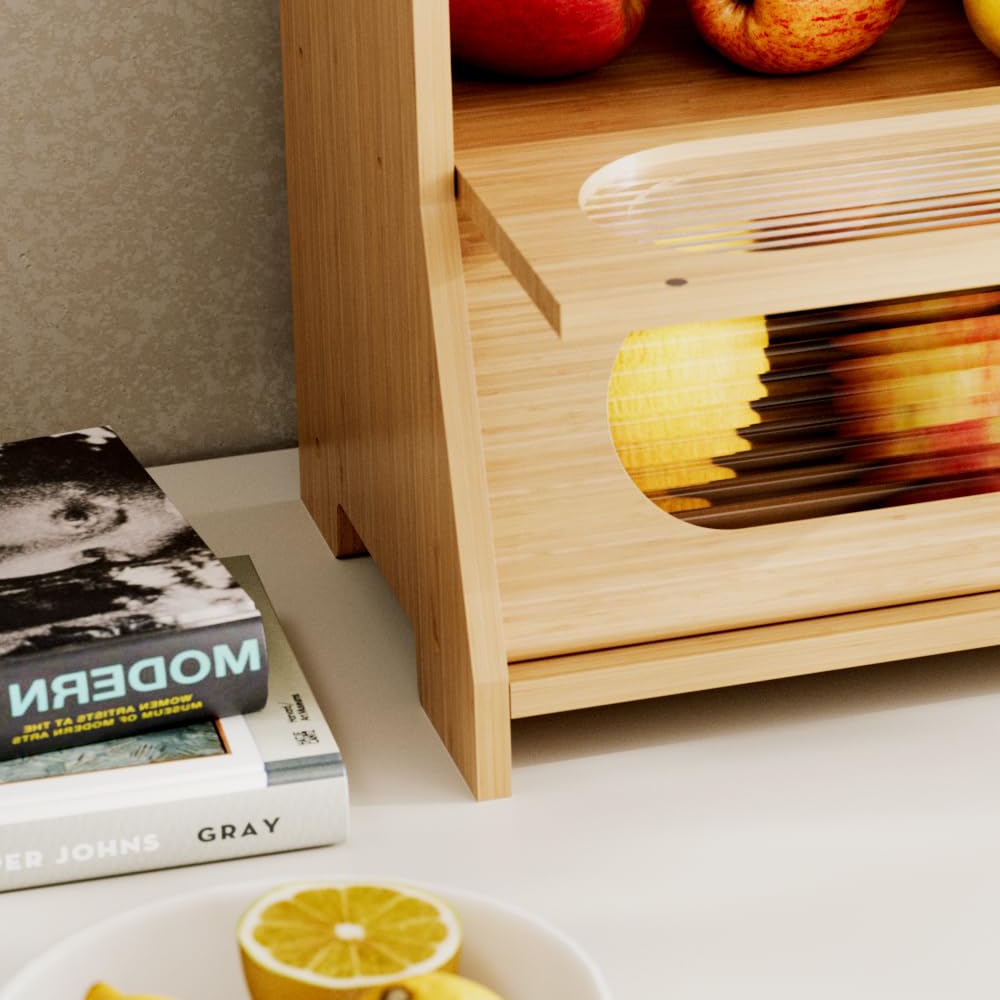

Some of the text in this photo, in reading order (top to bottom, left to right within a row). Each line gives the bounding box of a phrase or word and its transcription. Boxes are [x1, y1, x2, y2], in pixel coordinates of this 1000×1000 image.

[0, 816, 281, 872] ER JOHNS GRAY
